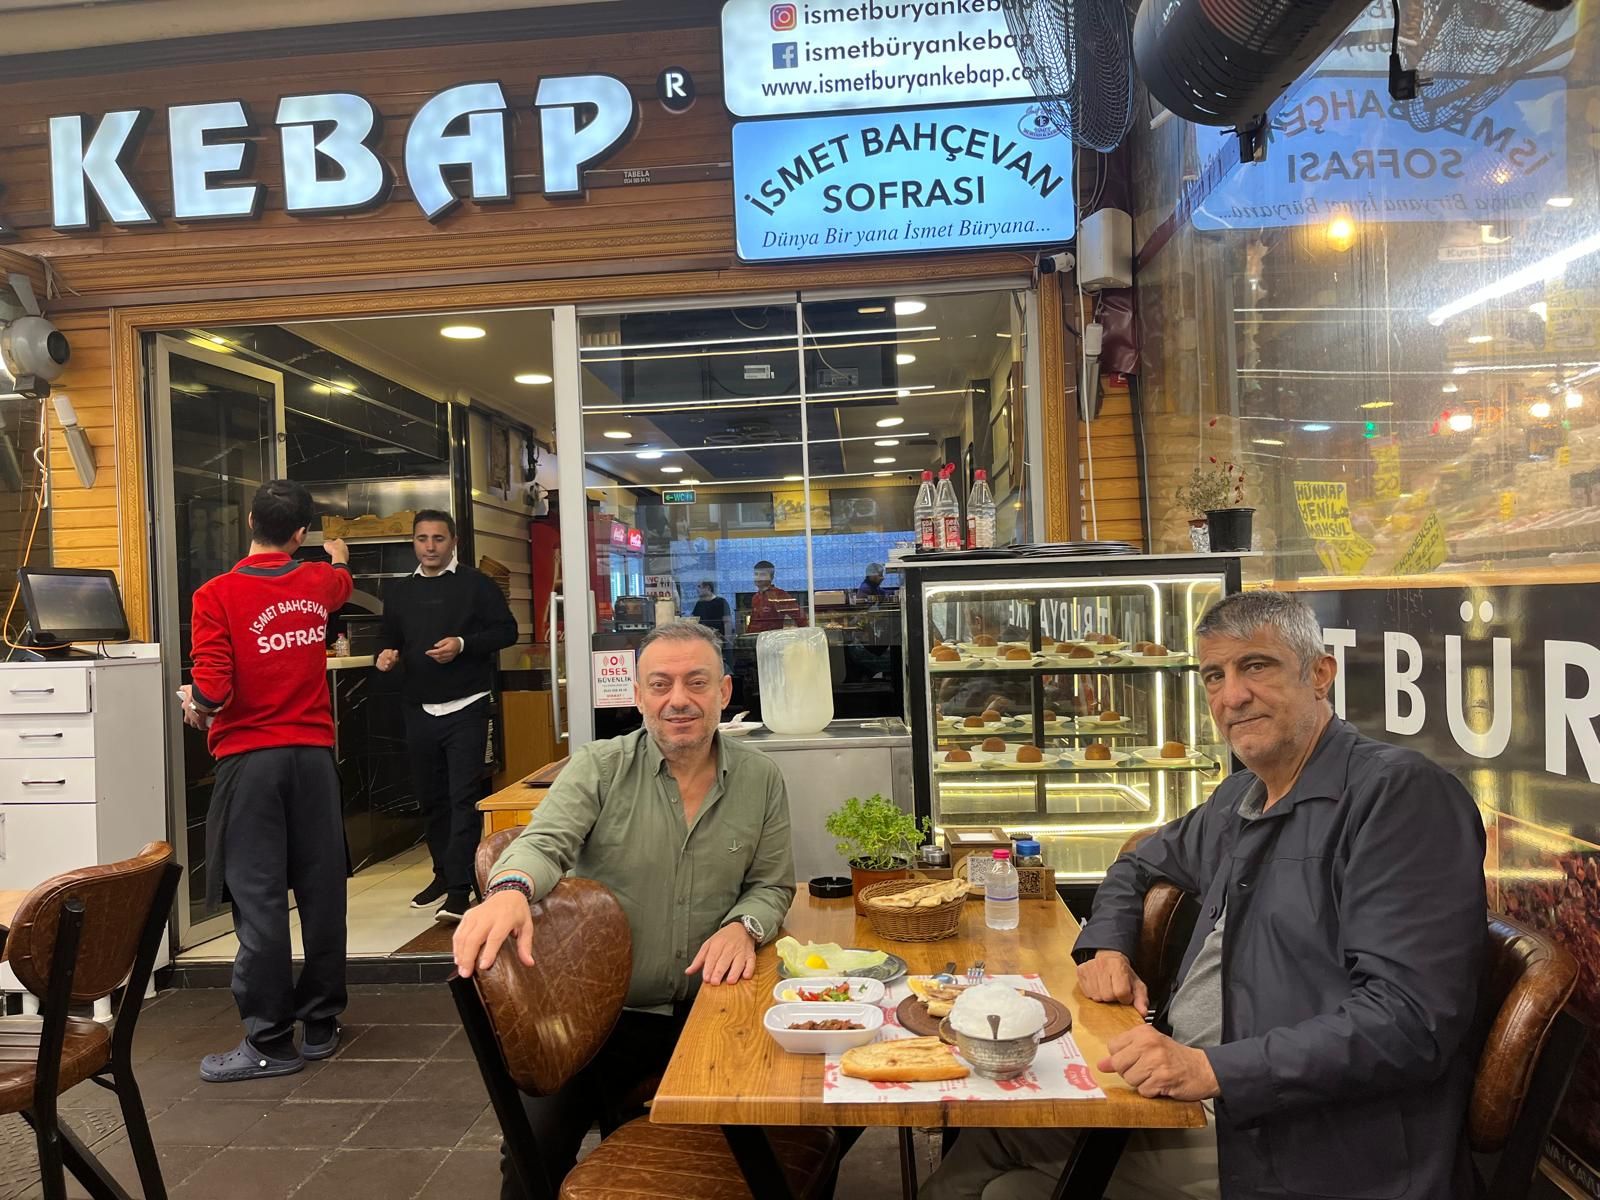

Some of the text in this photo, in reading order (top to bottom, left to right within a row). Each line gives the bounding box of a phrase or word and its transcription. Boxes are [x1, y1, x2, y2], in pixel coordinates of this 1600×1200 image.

[48, 75, 633, 226] KEBAP
[623, 170, 650, 178] TABELA
[744, 122, 1064, 216] İSMET BAHÇEVAN
[823, 176, 985, 214] SOFRASI
[762, 231, 819, 250] Dünya
[904, 220, 953, 240] İsmet
[959, 217, 1051, 240] Büryana...
[278, 599, 328, 621] BAHÇEVAN
